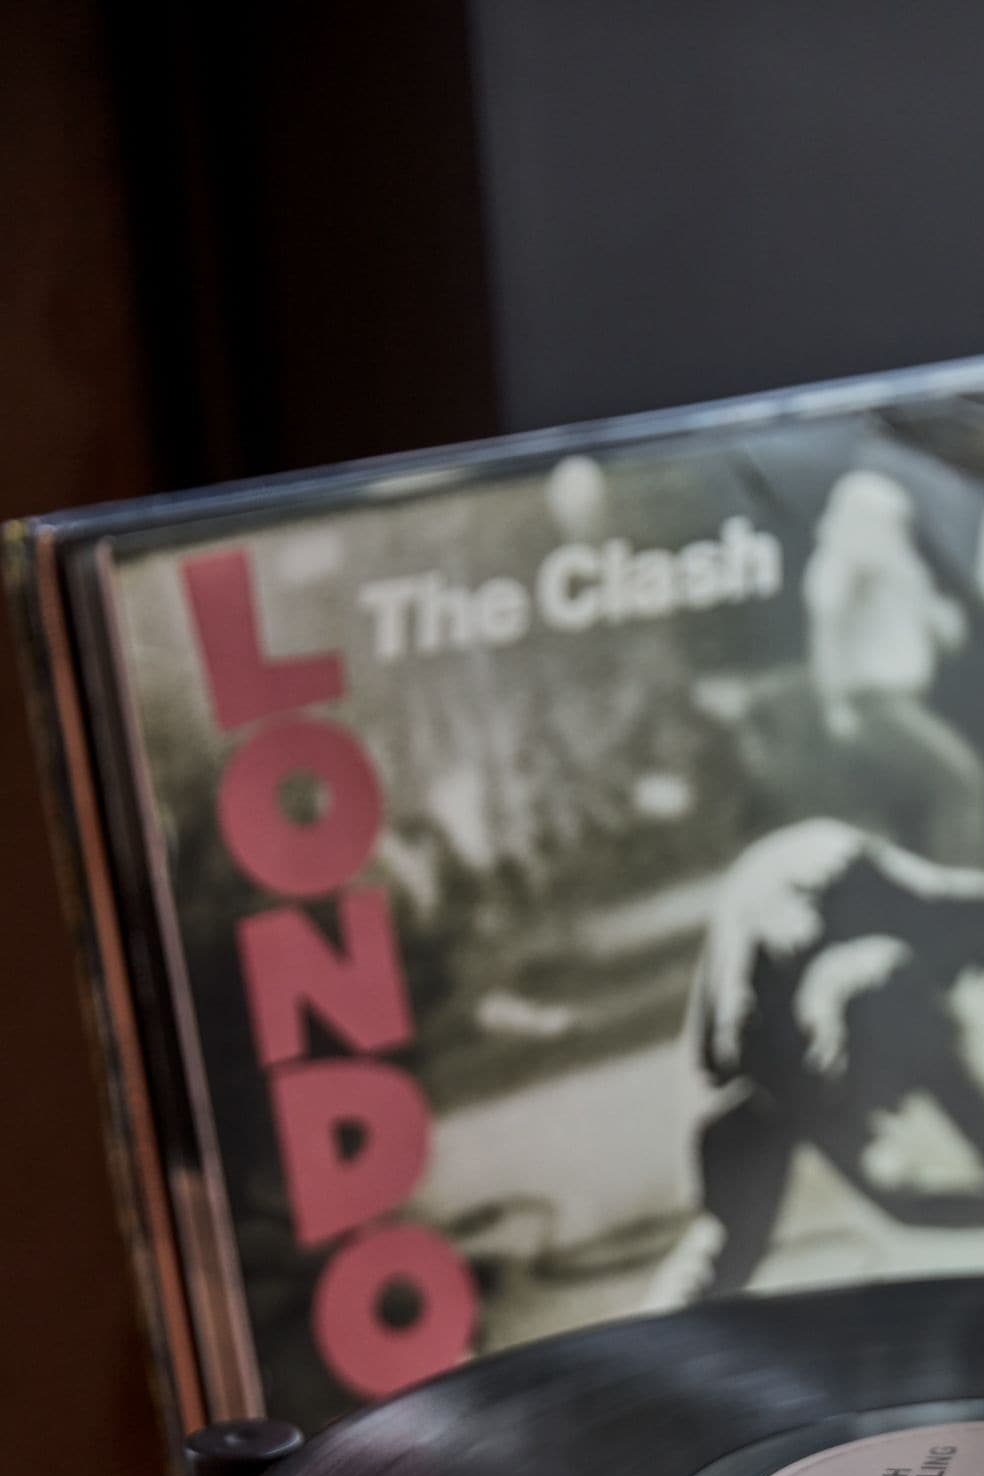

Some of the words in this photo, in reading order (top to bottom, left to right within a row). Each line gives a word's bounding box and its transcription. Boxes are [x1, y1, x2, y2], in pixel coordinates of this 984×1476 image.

[360, 572, 531, 660] The
[536, 514, 783, 632] Clash
[183, 550, 481, 1399] LONDO
